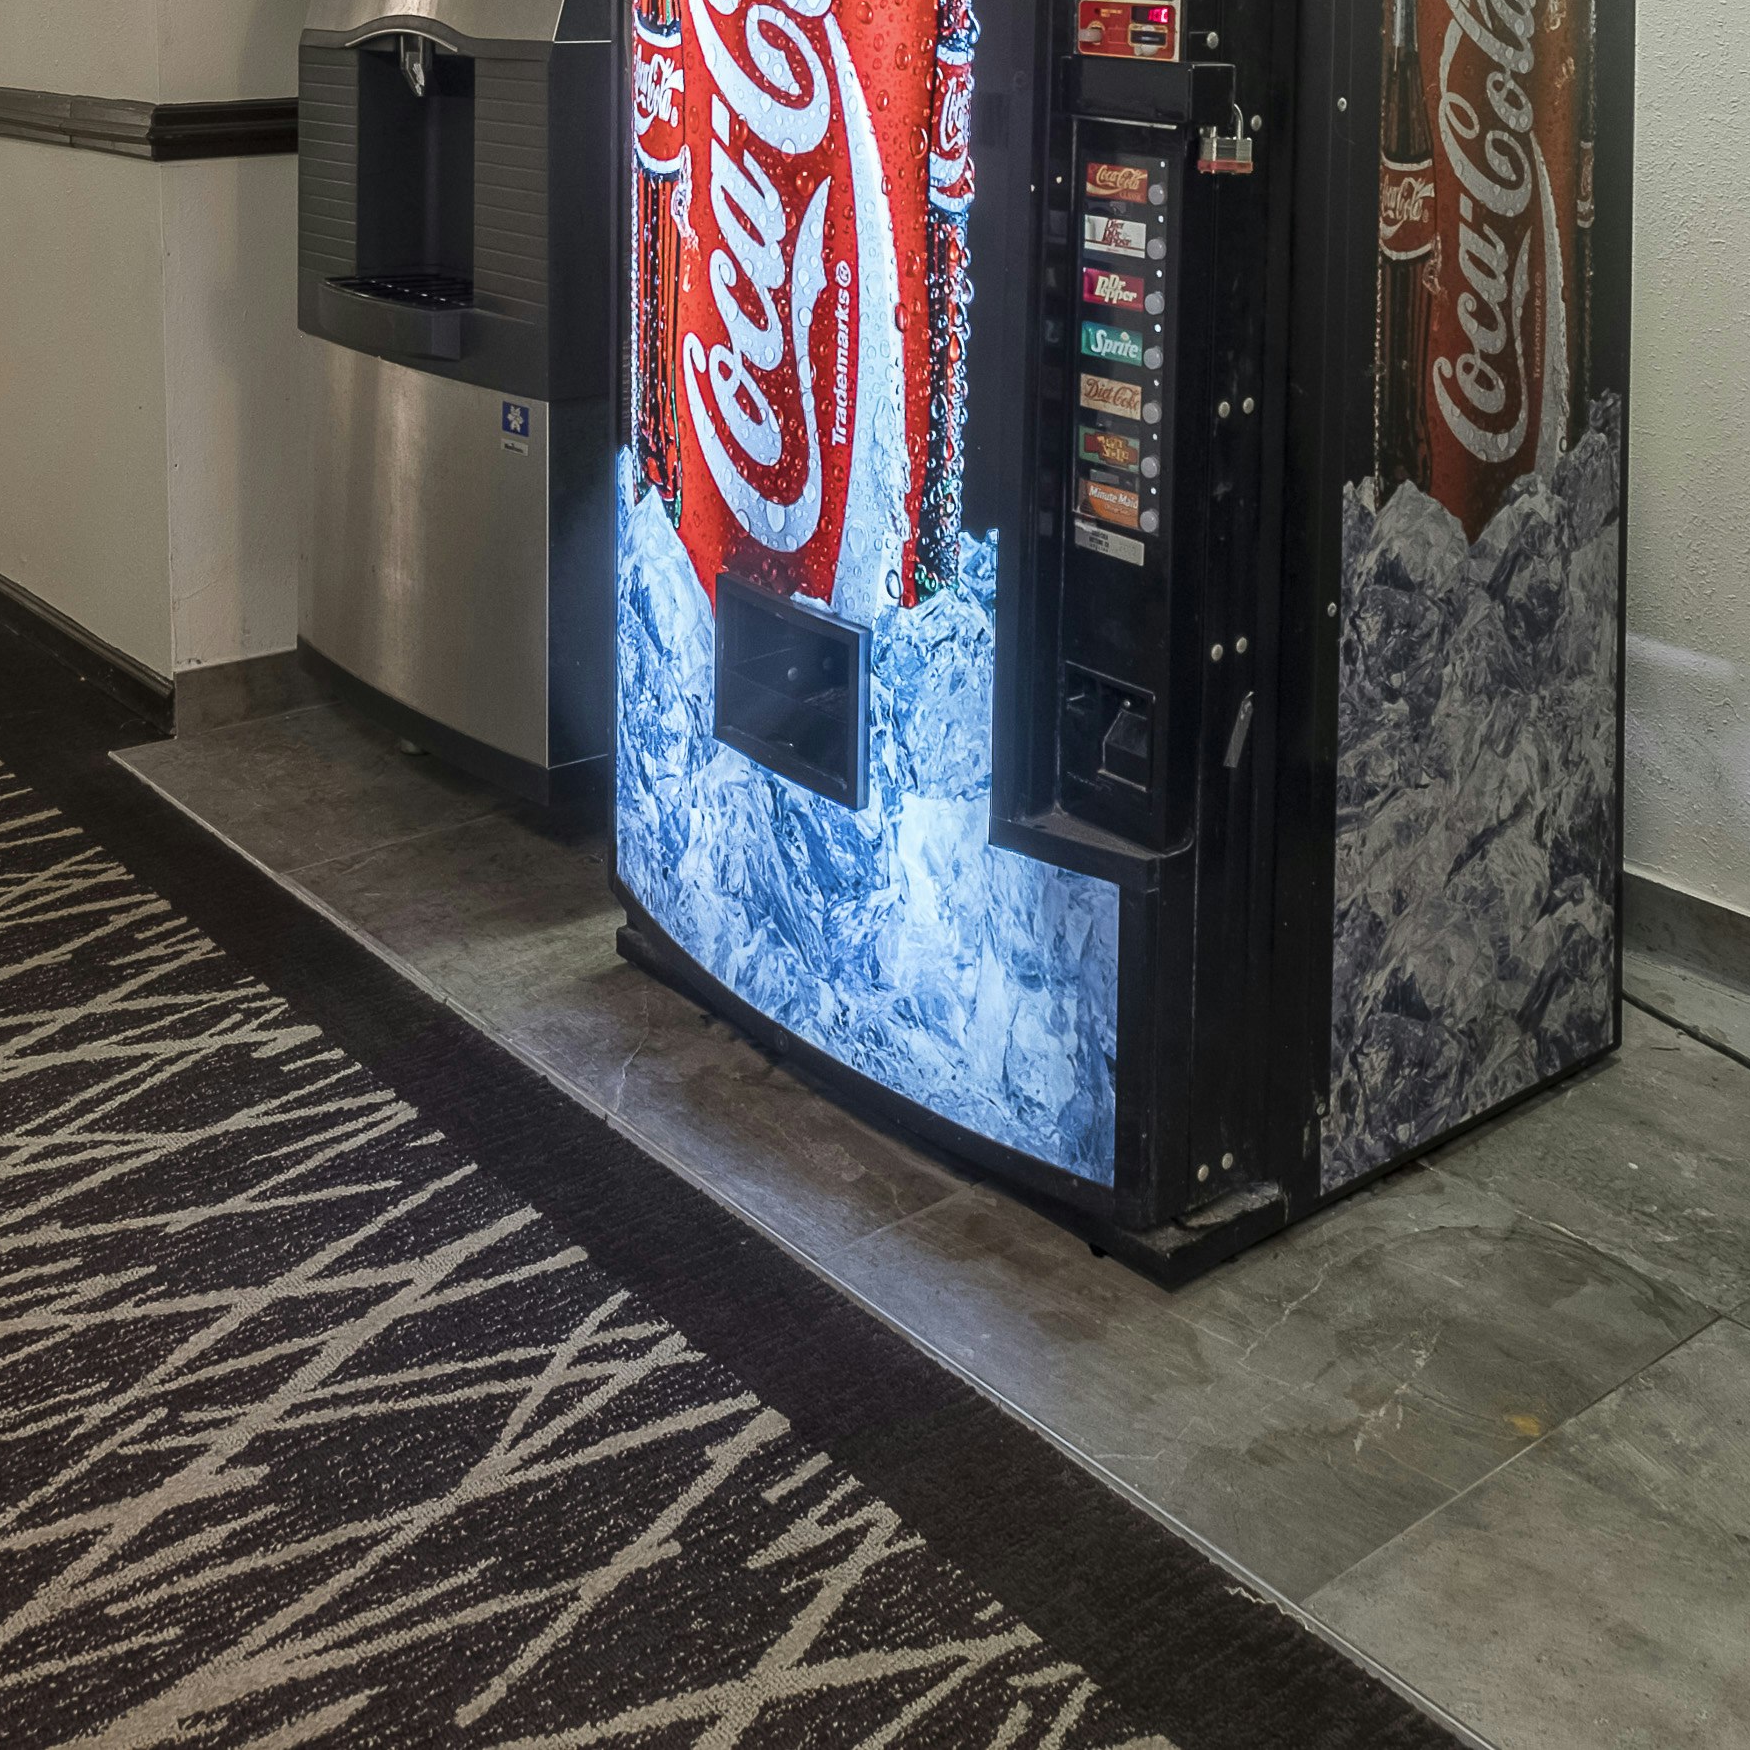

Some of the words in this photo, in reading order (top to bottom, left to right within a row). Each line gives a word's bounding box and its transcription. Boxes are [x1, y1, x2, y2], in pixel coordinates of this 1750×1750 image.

[1095, 275, 1137, 303] Pepper
[1091, 329, 1139, 358] Sprite
[1084, 378, 1111, 403] Diet
[1089, 486, 1117, 503] Minute
[1119, 493, 1138, 509] Maid
